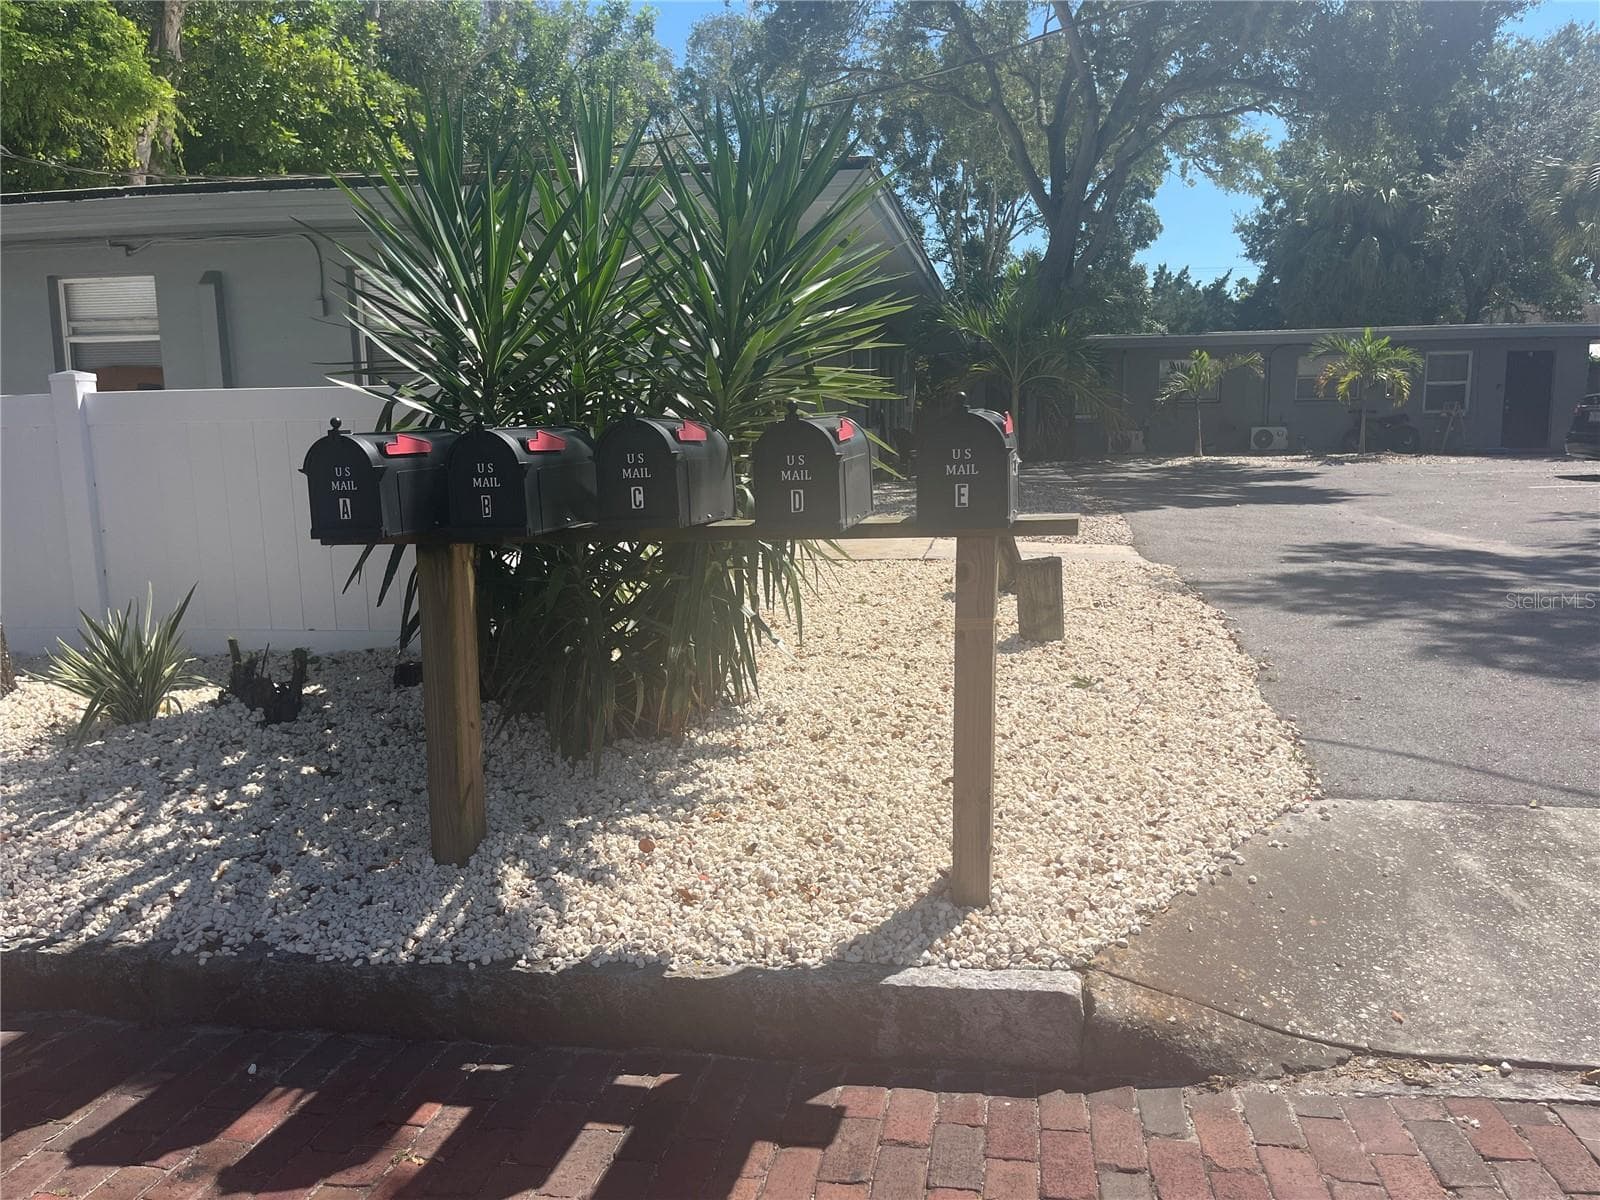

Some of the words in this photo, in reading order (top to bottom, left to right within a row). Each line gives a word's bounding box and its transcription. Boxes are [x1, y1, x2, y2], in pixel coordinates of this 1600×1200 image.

[622, 468, 651, 478] MAIL
[782, 470, 812, 480] MAIL
[946, 464, 978, 475] MAIL
[332, 480, 358, 490] MAIL
[473, 478, 500, 488] MAIL
[632, 488, 643, 508] C
[792, 490, 802, 512] D
[956, 484, 968, 506] E
[340, 499, 350, 518] A
[482, 496, 490, 516] B
